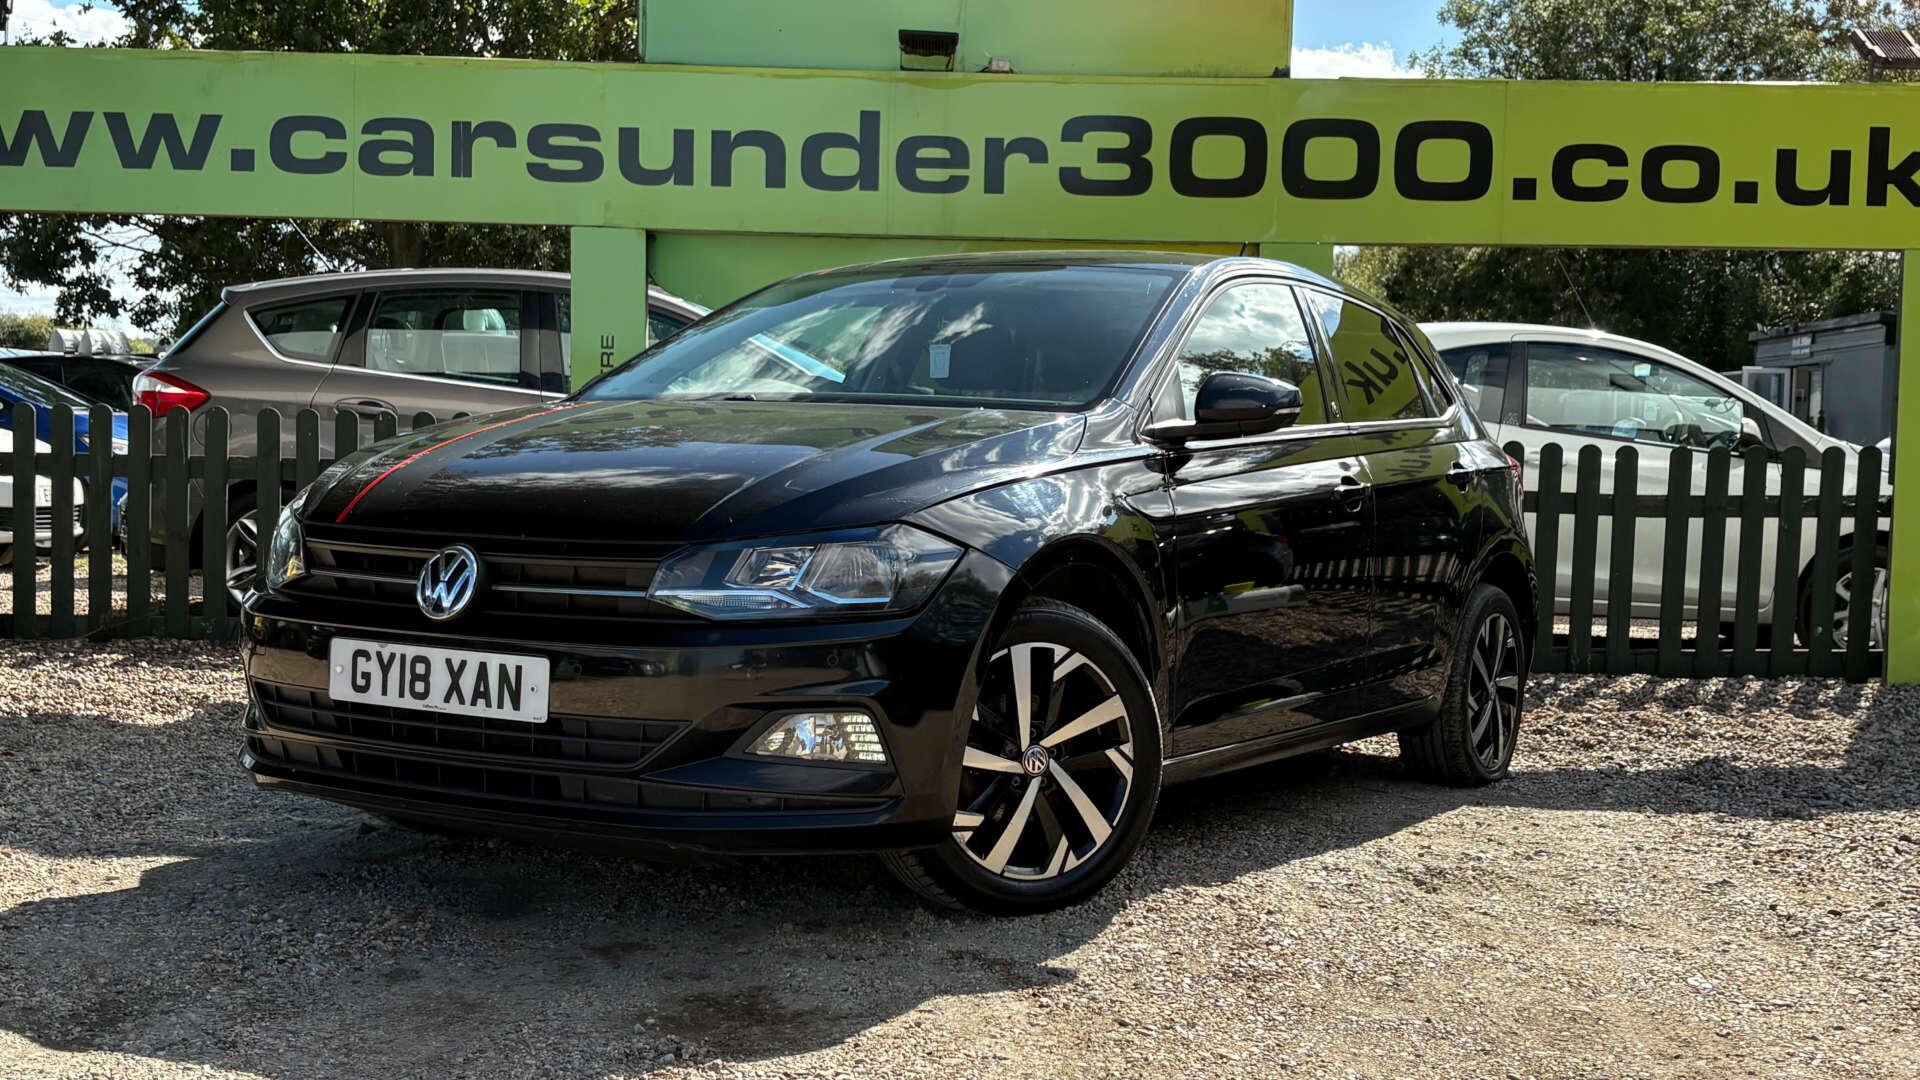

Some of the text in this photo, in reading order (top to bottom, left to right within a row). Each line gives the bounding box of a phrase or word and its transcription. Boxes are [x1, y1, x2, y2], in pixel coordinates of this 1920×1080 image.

[600, 335, 615, 375] RE
[351, 648, 523, 712] GY18 XAN
